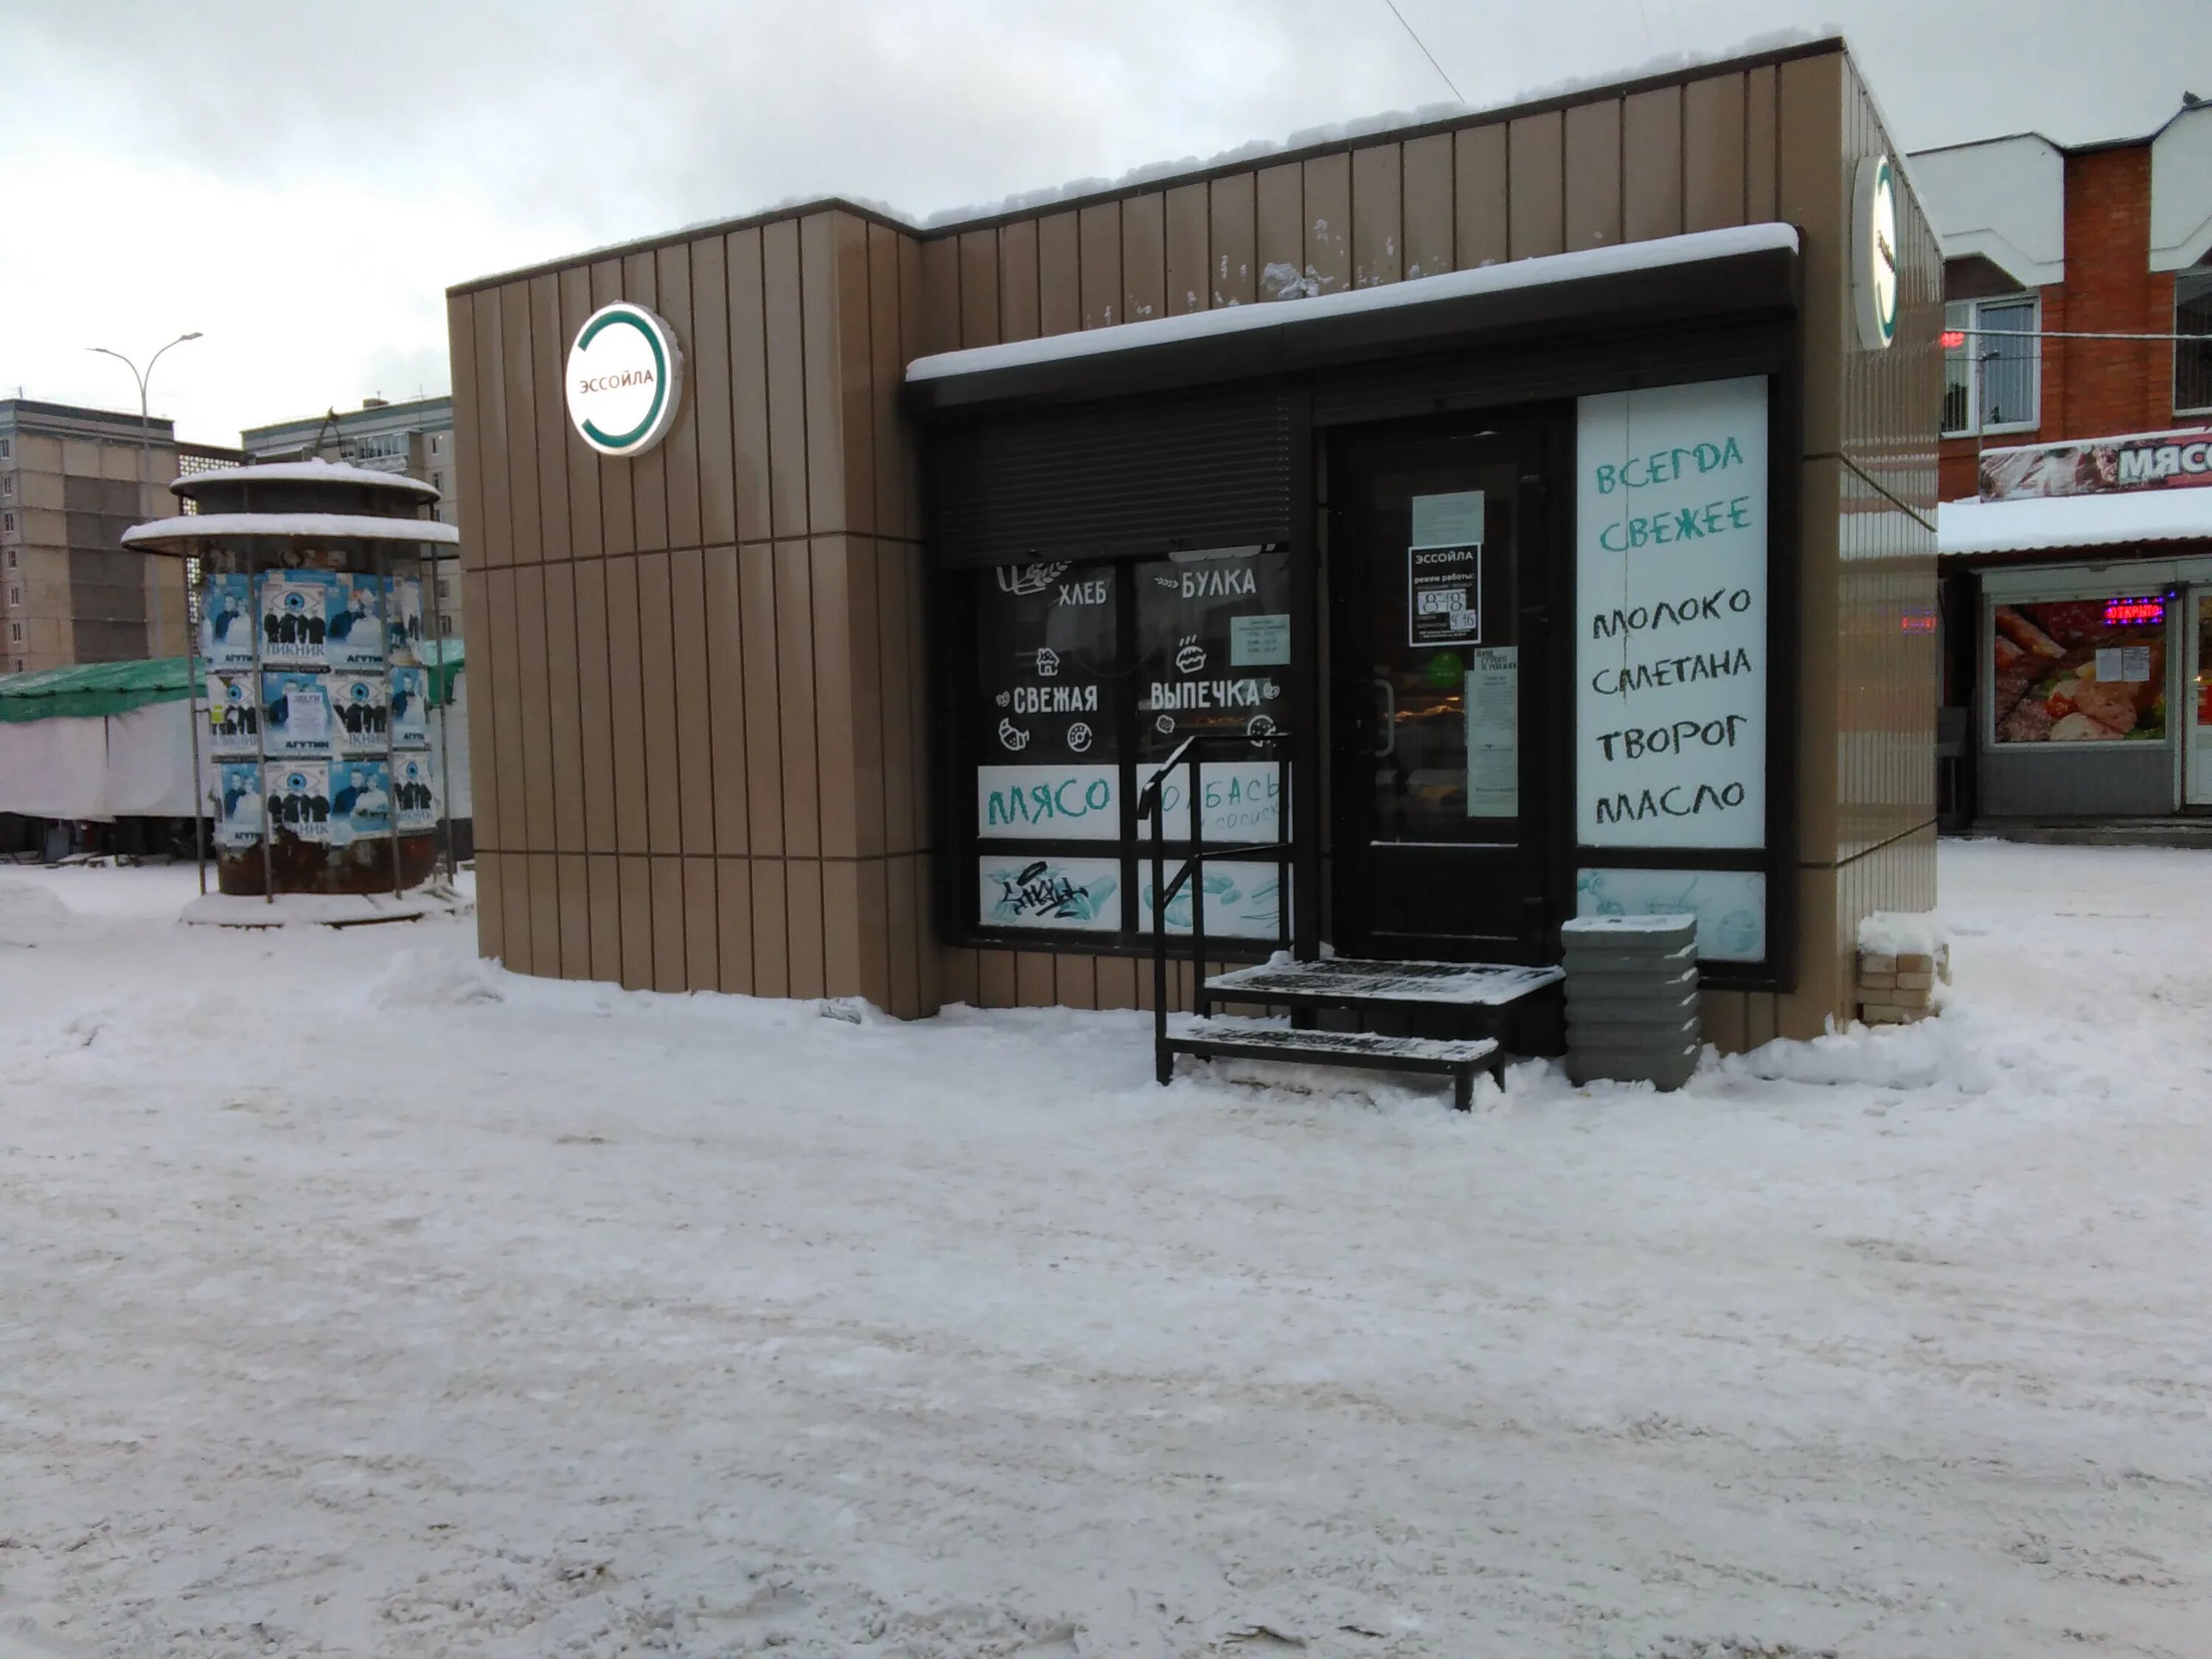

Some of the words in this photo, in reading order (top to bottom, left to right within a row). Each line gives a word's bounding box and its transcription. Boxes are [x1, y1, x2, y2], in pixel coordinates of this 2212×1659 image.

[580, 369, 654, 394] ЭССОЙЛА
[1596, 437, 1743, 494] ВСЕГДА
[2118, 442, 2212, 484] МЯС
[1599, 495, 1752, 552] СВЕЖЕЕ
[1415, 550, 1474, 565] ЭССОЙЛА
[1059, 581, 1107, 606] ХЛЕБ
[1182, 568, 1256, 599] БУЛКА
[1414, 575, 1441, 585] режим
[1593, 588, 1751, 639] МОЛОКО
[1592, 647, 1752, 695] СМЕТАНА
[1014, 685, 1098, 714] СВЕЖАЯ
[1151, 679, 1260, 710] ВЫПЕЧКА
[285, 740, 329, 748] АГУТИН
[1596, 714, 1747, 761] ТВОРОГ
[989, 779, 1110, 824] МЯСО
[1596, 782, 1745, 824] МАСЛО
